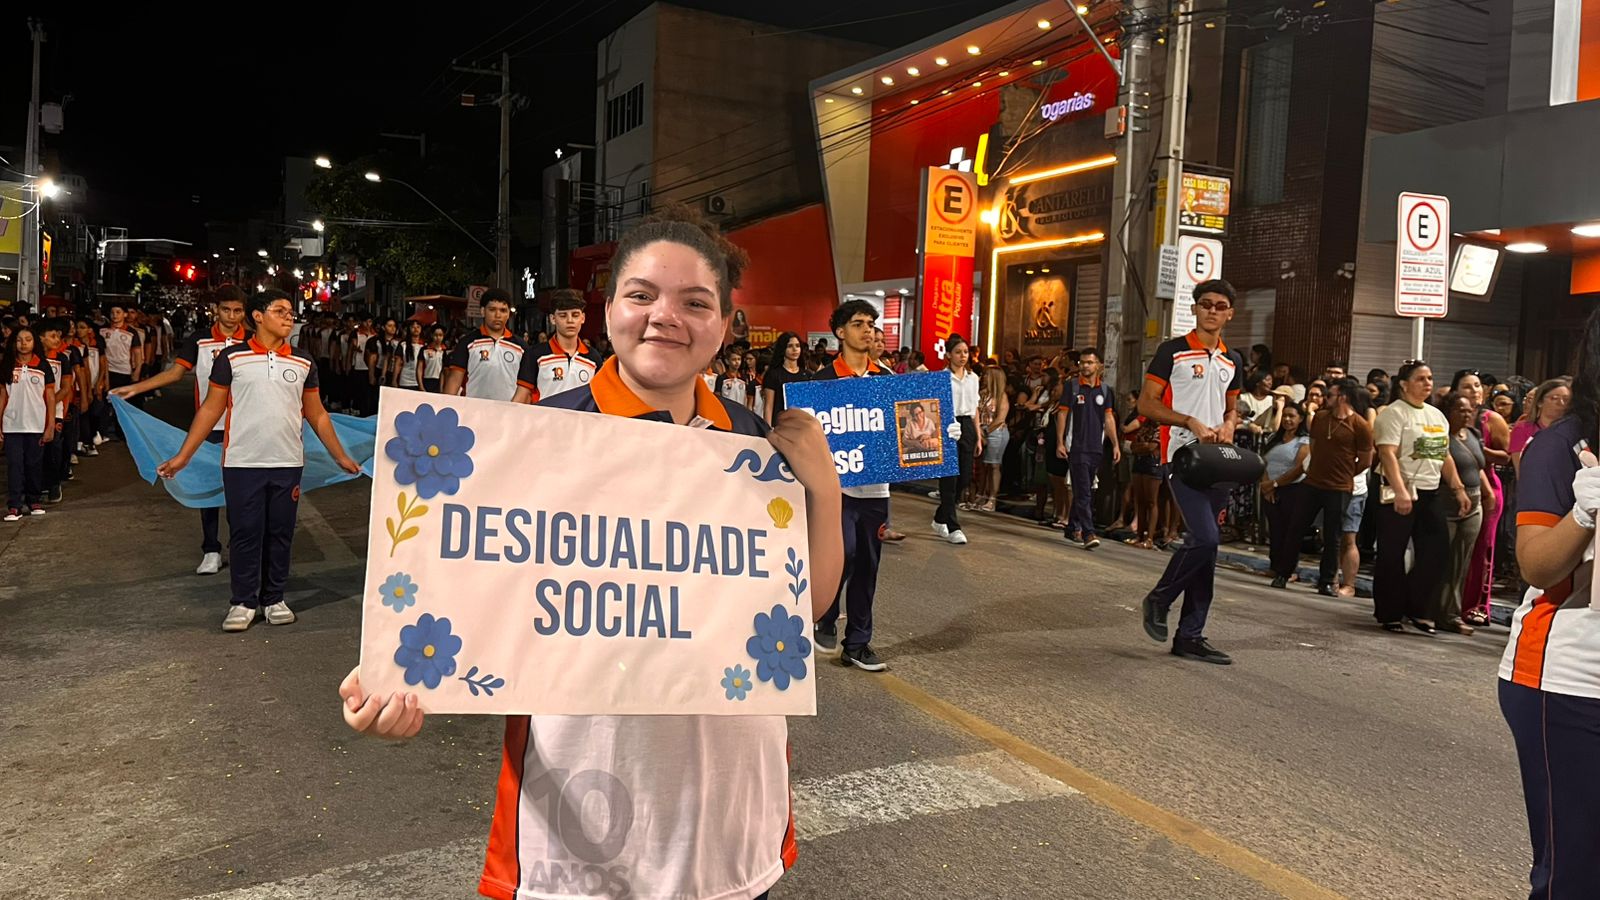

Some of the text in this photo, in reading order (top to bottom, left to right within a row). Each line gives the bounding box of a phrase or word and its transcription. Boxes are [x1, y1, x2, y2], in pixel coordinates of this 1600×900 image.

[1041, 91, 1095, 121] ogarias
[944, 185, 963, 214] E
[1418, 214, 1429, 239] E
[1195, 253, 1205, 274] E
[1404, 265, 1442, 275] ZONA AZUL
[551, 367, 564, 377] 10
[1218, 446, 1242, 460] JBL
[439, 502, 770, 578] DESIGUALDADE
[533, 578, 693, 639] SOCIAL
[526, 767, 634, 865] 10
[527, 859, 632, 899] ANOS
